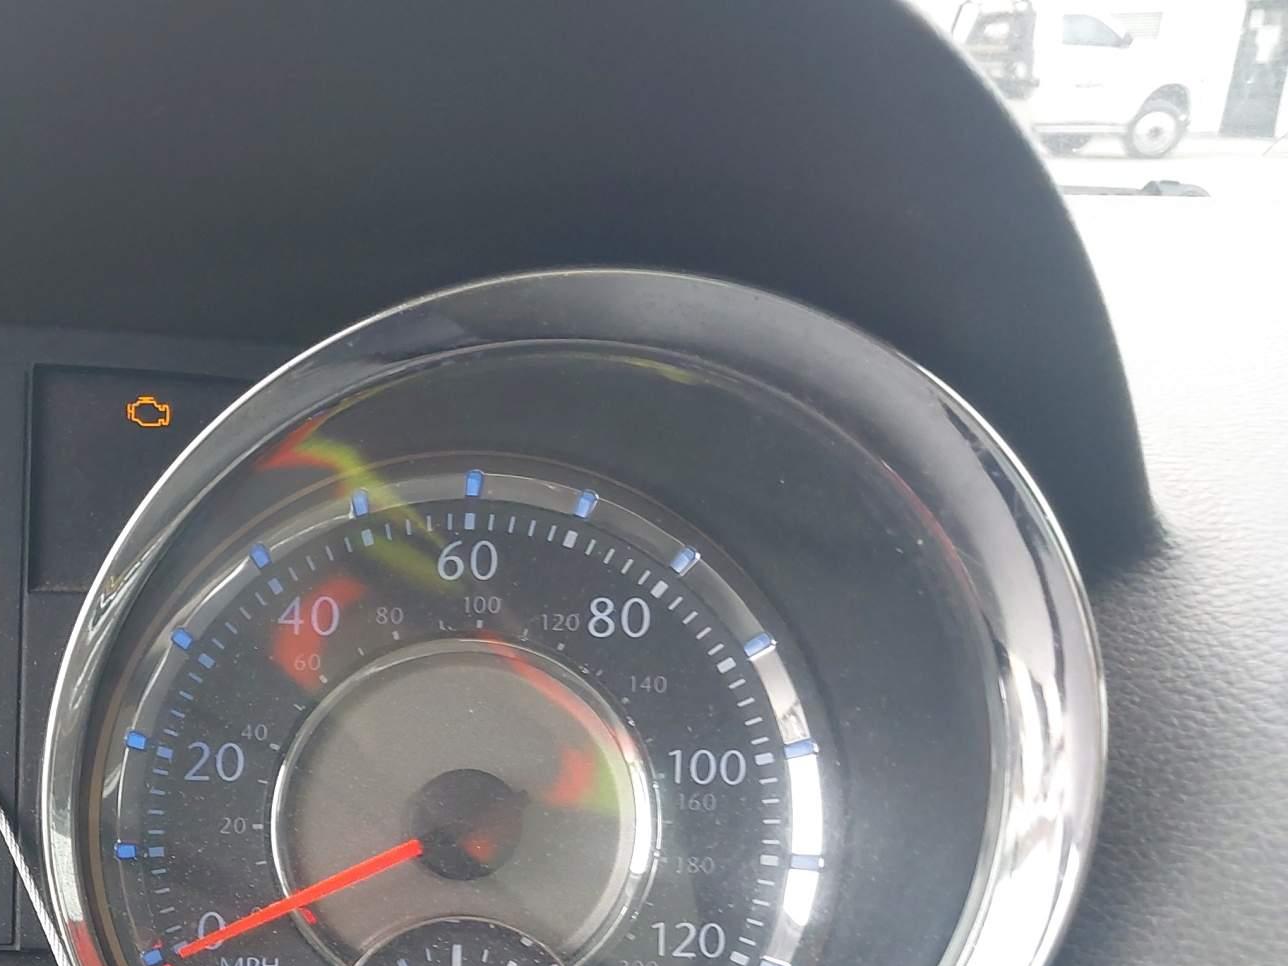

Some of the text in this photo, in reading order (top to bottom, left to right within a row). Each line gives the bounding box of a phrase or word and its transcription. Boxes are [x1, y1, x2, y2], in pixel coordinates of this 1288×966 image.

[437, 540, 498, 581] 60
[464, 596, 502, 614] 100
[277, 596, 340, 636] 40
[375, 607, 404, 625] 80
[540, 613, 580, 632] 120
[587, 597, 651, 638] 80
[294, 654, 321, 671] 60
[630, 676, 667, 694] 140
[241, 724, 268, 741] 40
[184, 742, 245, 781] 20
[668, 750, 746, 785] 100
[679, 793, 716, 811] 160
[220, 817, 246, 834] 20
[675, 856, 715, 874] 180
[198, 911, 226, 950] 0
[651, 922, 726, 958] 120
